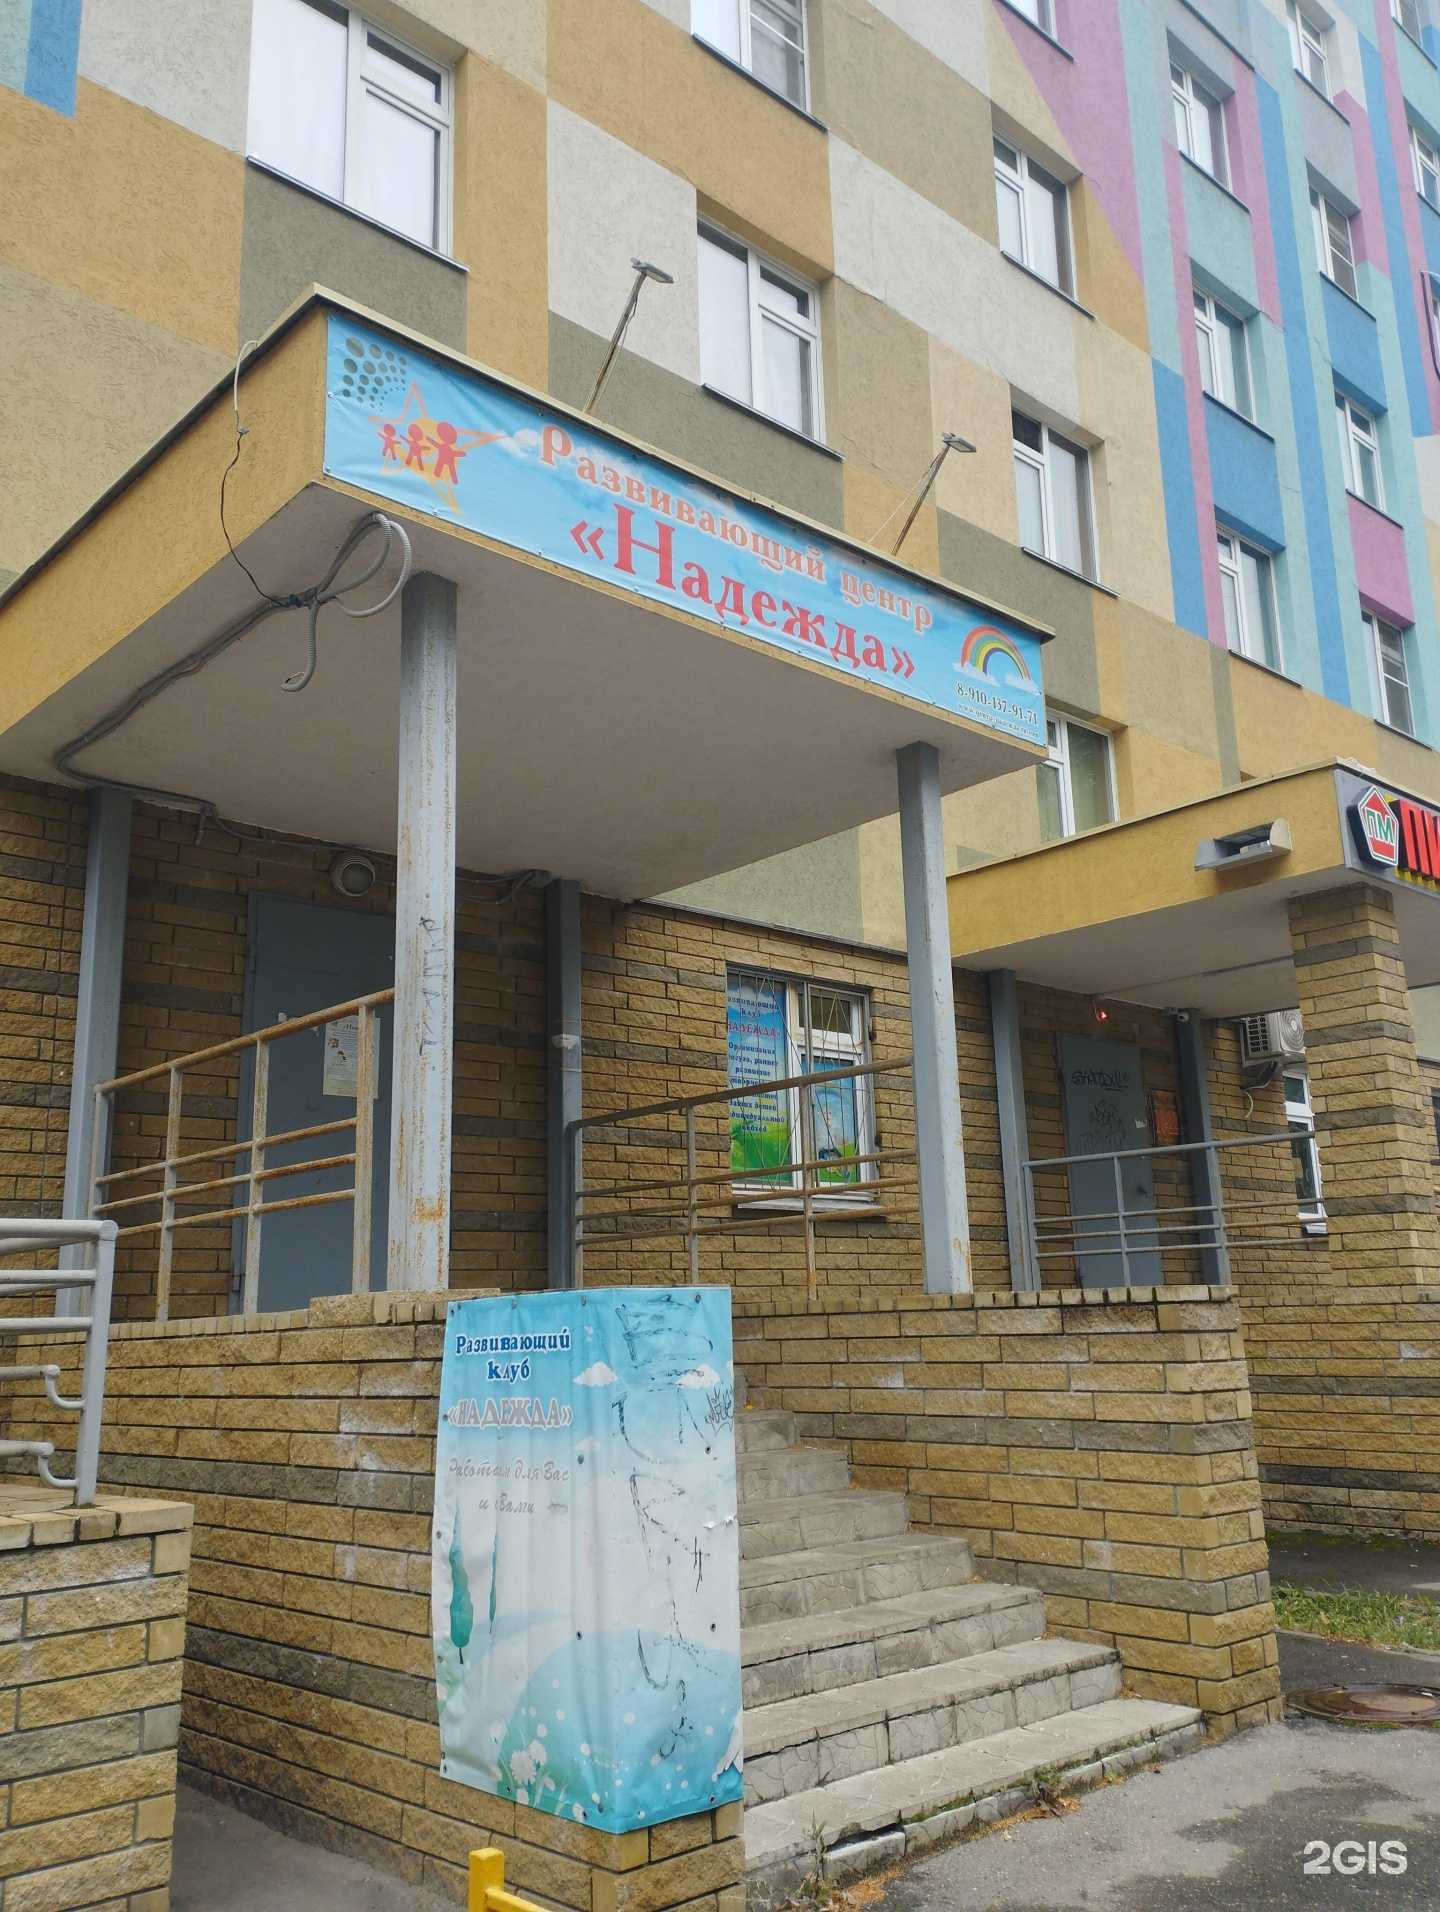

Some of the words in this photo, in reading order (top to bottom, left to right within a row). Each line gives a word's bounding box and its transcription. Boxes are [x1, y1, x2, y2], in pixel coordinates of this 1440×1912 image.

[540, 424, 826, 581] Развивающий
[841, 571, 933, 632] центр
[569, 503, 916, 679] «Надежда»
[1365, 809, 1395, 844] ПМ
[455, 1328, 571, 1354] Развивающий
